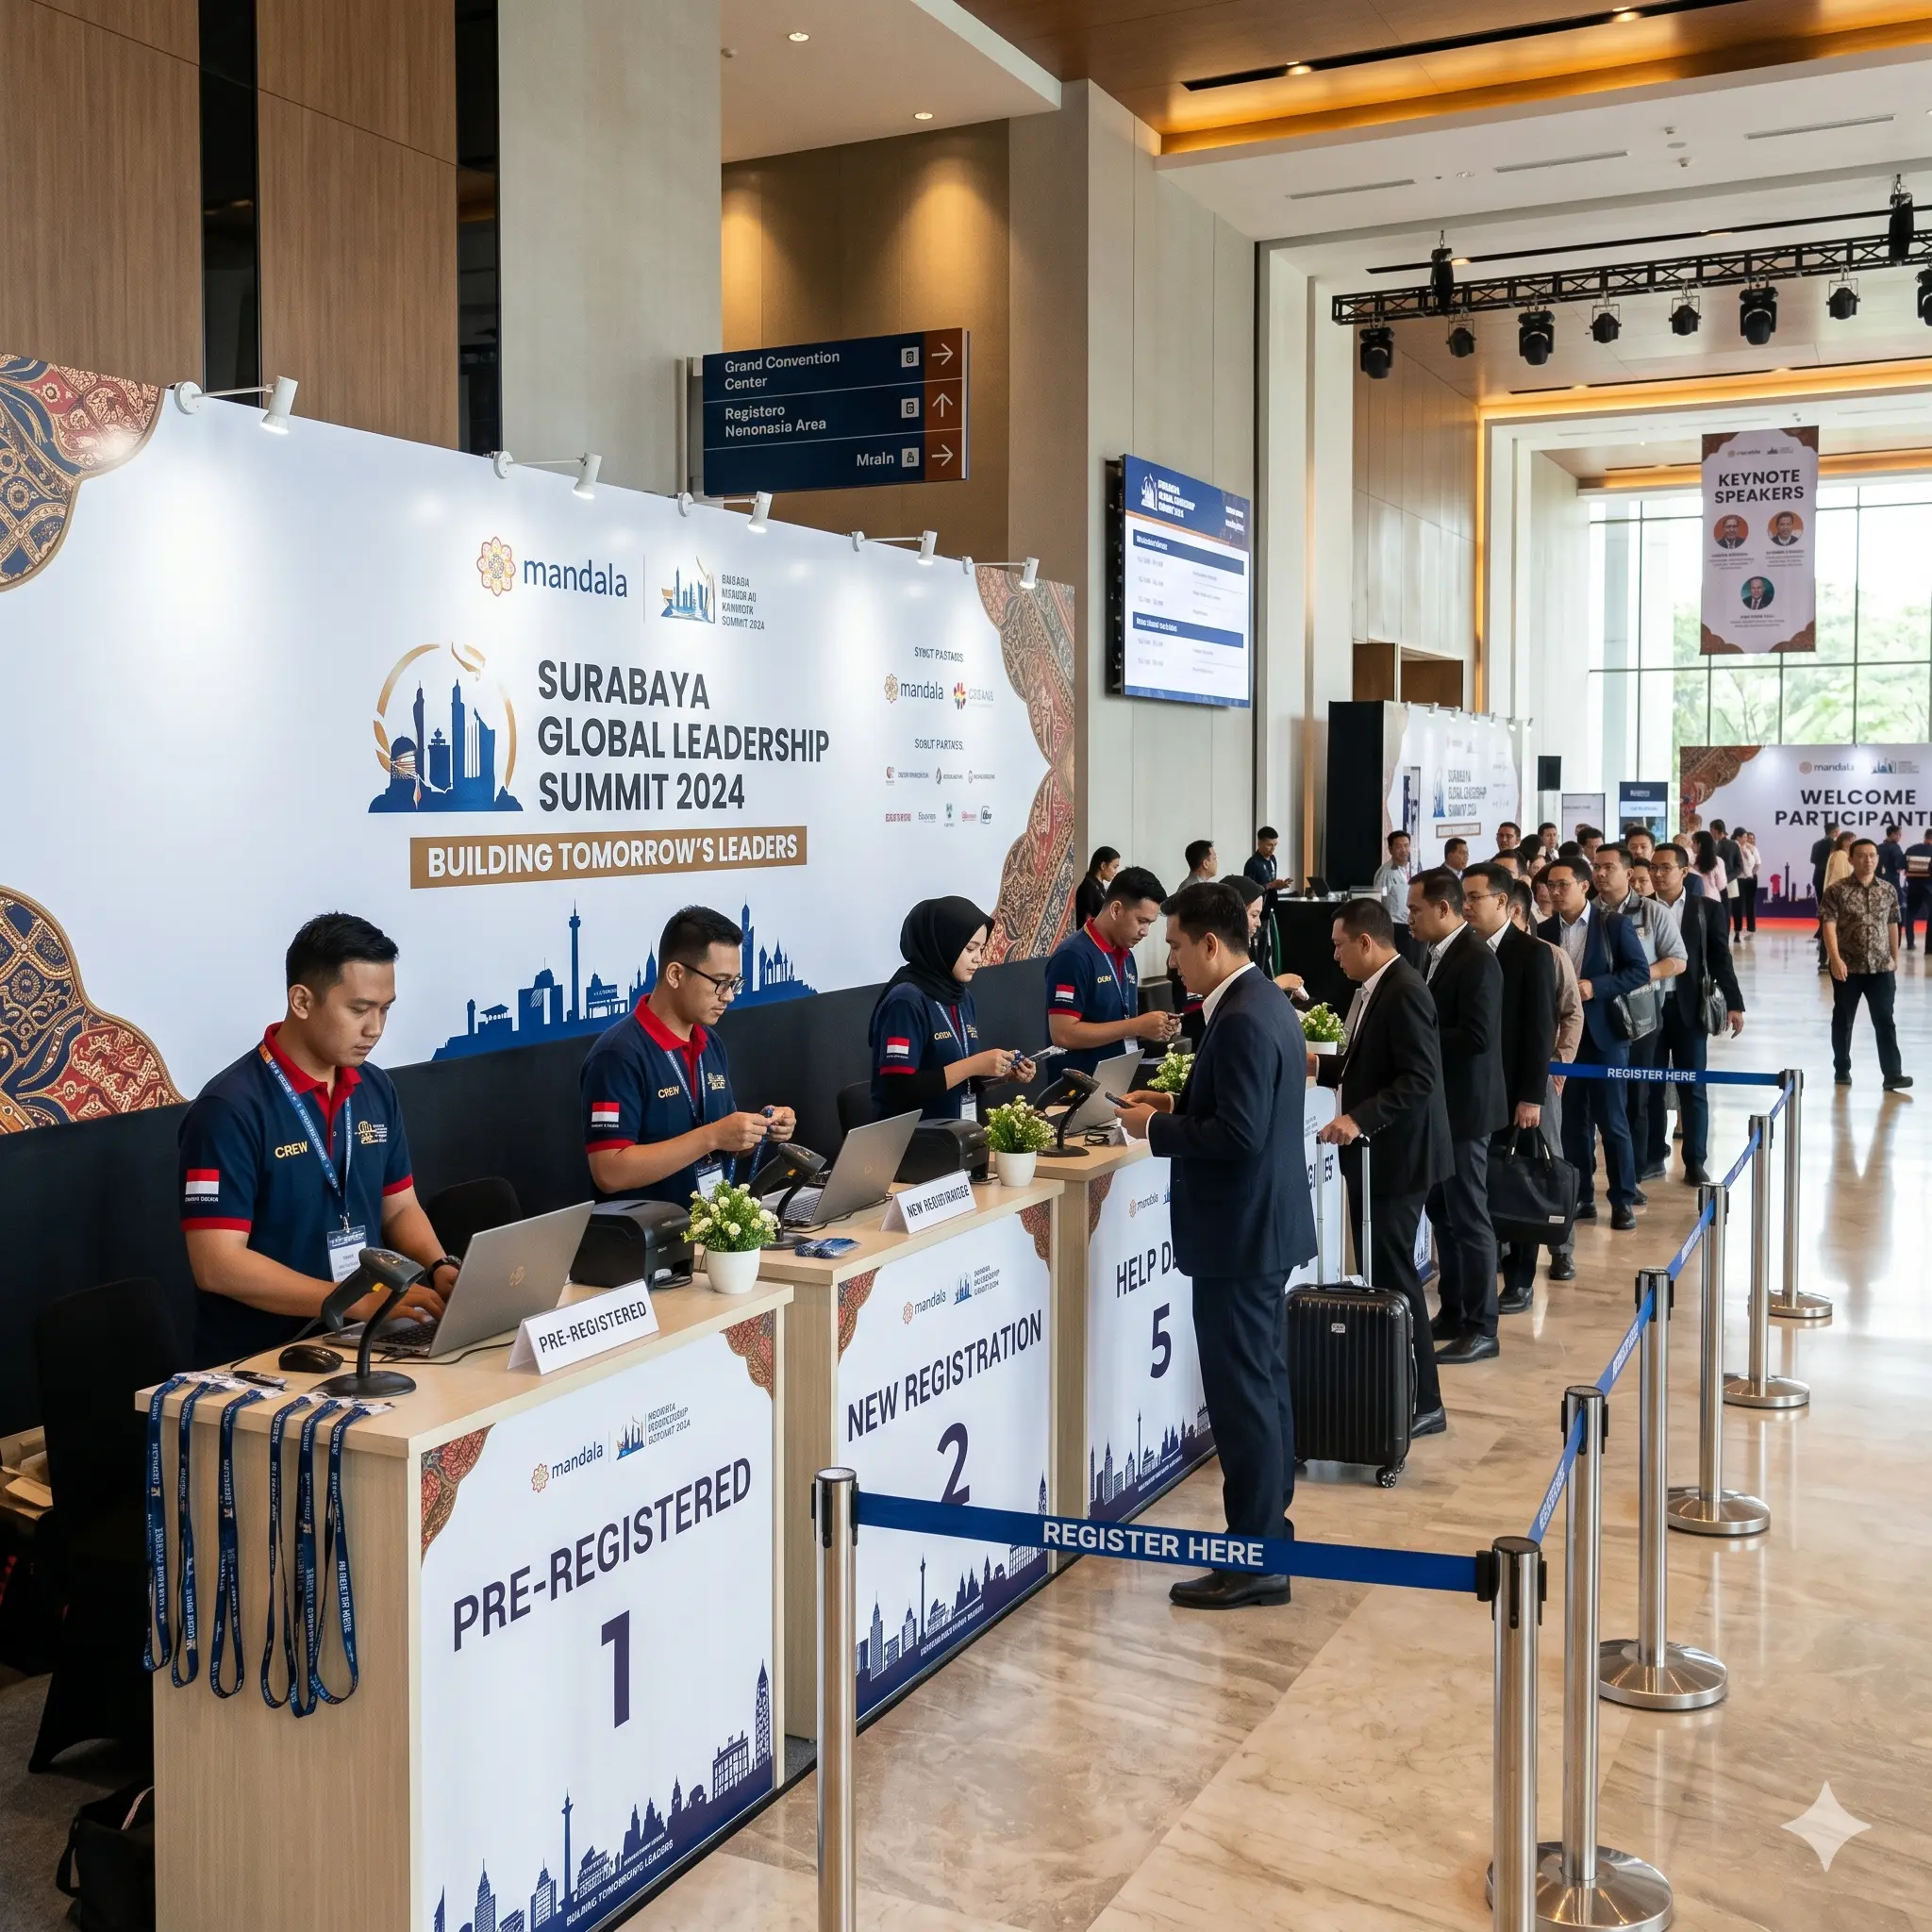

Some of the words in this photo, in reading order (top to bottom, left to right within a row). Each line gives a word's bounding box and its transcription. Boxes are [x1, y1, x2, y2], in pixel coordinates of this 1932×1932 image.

[724, 357, 763, 374] Grand
[765, 351, 841, 369] Convention
[724, 375, 768, 391] Center
[724, 405, 786, 423] Registero
[724, 422, 792, 438] Nenonasia
[795, 418, 826, 432] Area
[1714, 486, 1805, 504] SPEAKERS
[1718, 469, 1801, 487] KEYNOTE
[524, 559, 628, 598] mandala
[538, 658, 710, 710] SURABAYA
[900, 681, 944, 700] mandala
[538, 716, 666, 759] GLOBAL
[673, 723, 830, 763] LEADERSHIP
[539, 772, 669, 812] SUMMIT
[676, 774, 745, 810] 2024
[1800, 790, 1917, 805] WELCOME
[1774, 810, 1932, 827] PARTICIPANT
[427, 841, 554, 878] BUILDING
[558, 836, 715, 872] TOMORROW’S
[718, 834, 798, 862] LEADERS
[658, 1086, 679, 1098] CREW
[1607, 1068, 1663, 1080] REGISTER
[1665, 1071, 1696, 1082] HERE
[275, 1141, 308, 1158] CREW
[906, 1202, 924, 1218] NEW
[1116, 1248, 1157, 1299] HELP
[539, 1301, 647, 1353] PRE-REGISTERED
[1150, 1302, 1172, 1379] 5
[848, 1381, 899, 1443] NEW
[905, 1308, 1042, 1412] REGISTRATION
[551, 1441, 603, 1479] mandala
[936, 1422, 971, 1506] 2
[453, 1457, 752, 1653] PRE-REGISTERED
[1042, 1521, 1180, 1558] REGISTER
[1189, 1537, 1264, 1567] HERE
[600, 1609, 630, 1729] 1
